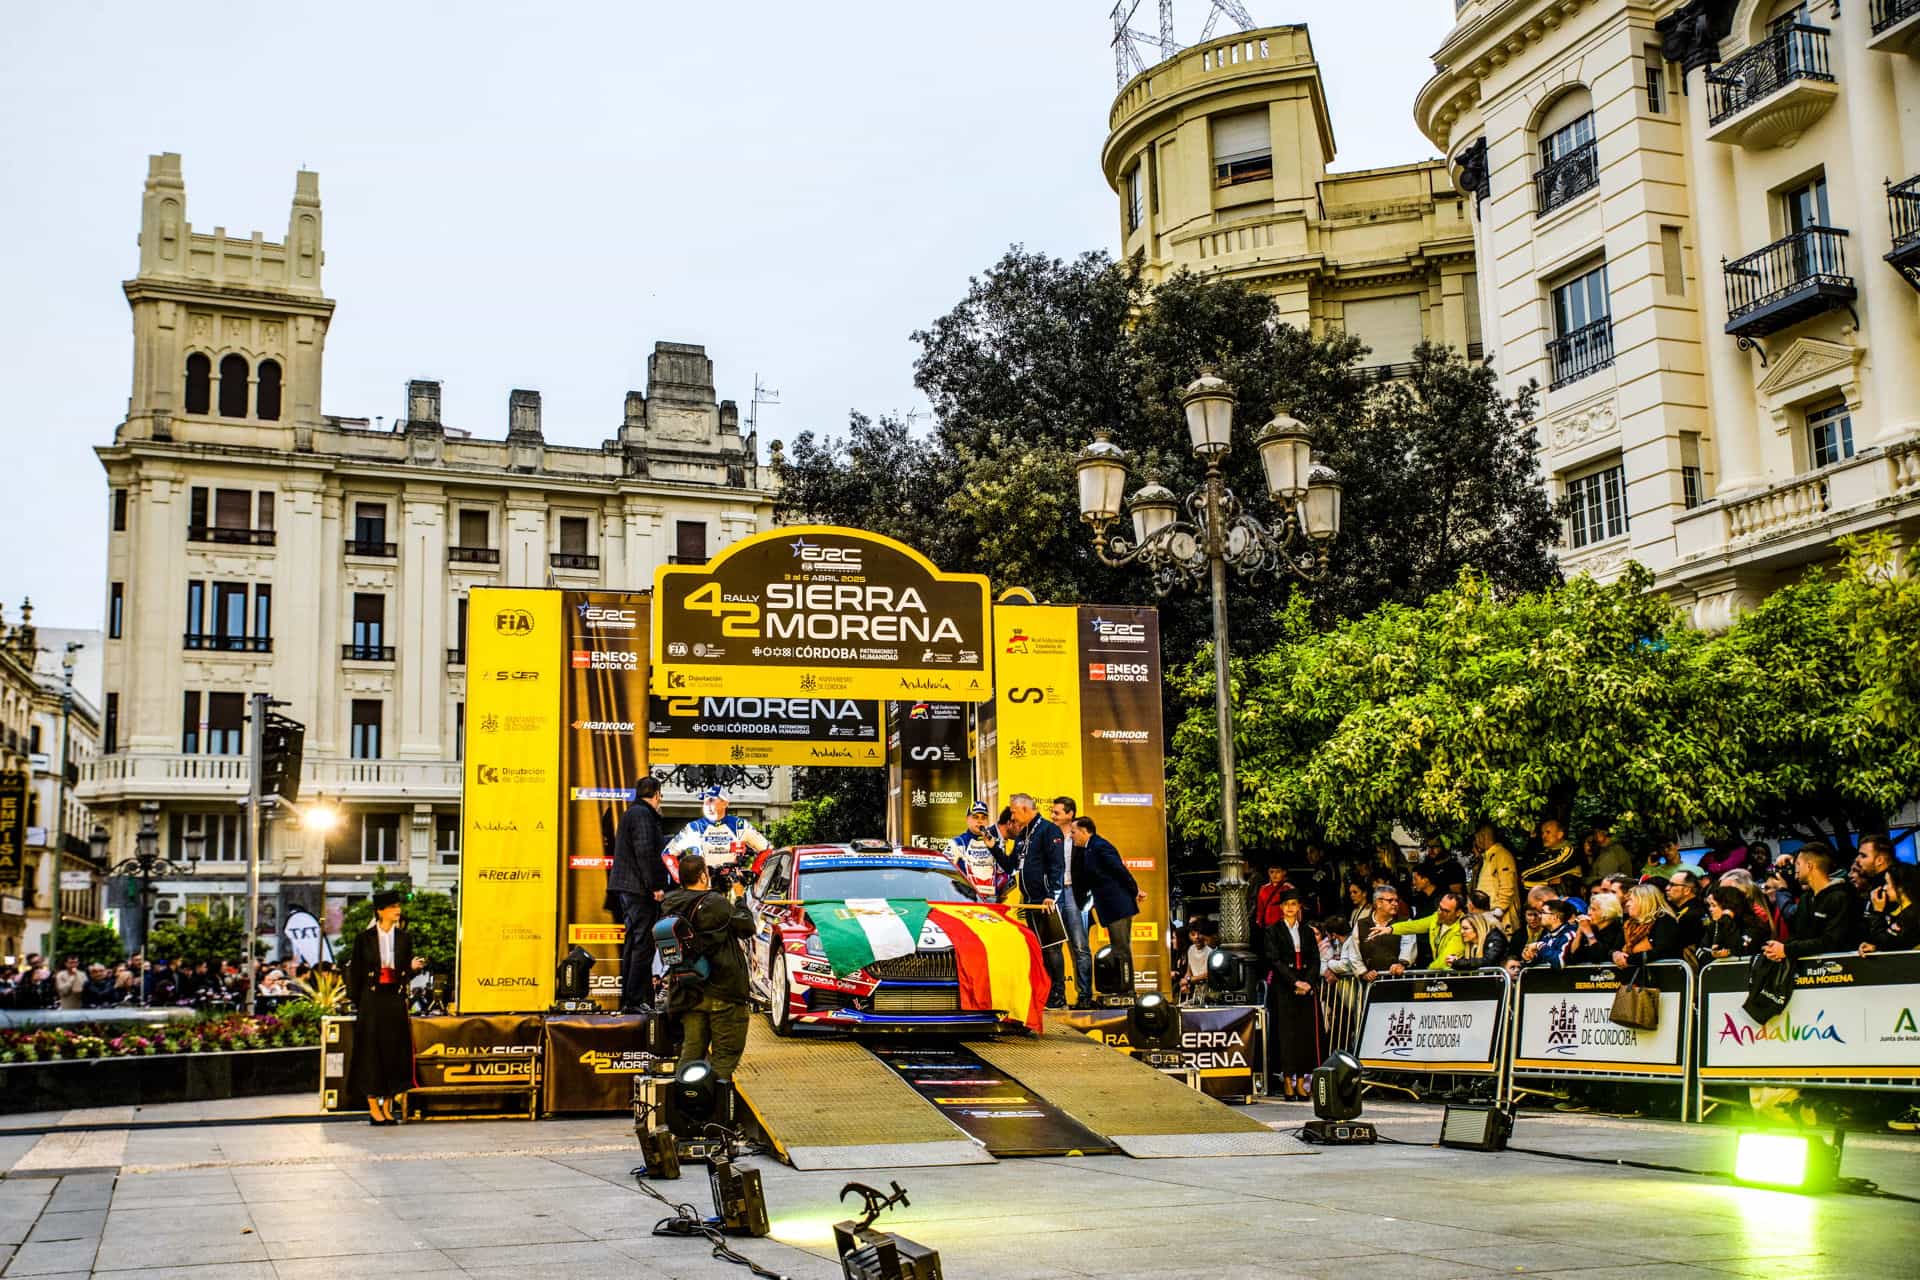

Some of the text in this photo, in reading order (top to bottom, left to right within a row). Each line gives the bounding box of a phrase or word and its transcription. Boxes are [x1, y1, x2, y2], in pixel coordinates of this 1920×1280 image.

[800, 547, 862, 562] ERC
[811, 575, 840, 583] ABRIL
[724, 594, 760, 603] RALLY
[766, 583, 928, 614] SIERRA
[586, 608, 637, 621] ERC
[766, 612, 964, 644] MORENA
[1099, 623, 1145, 636] ERC
[591, 651, 638, 663] ENEOS
[795, 645, 858, 660] CÓRDOBA
[591, 663, 623, 671] MOTOR
[1106, 664, 1148, 675] ENEOS
[1106, 674, 1149, 682] MOTOR OIL
[704, 696, 863, 720] MORENA
[727, 722, 777, 734] CÓRDOBA
[502, 767, 546, 777] Diputación
[488, 869, 532, 881] Recalvi
[1200, 882, 1217, 893] AS
[1807, 968, 1828, 978] Rally
[477, 977, 540, 987] VALRENTAL
[1816, 974, 1854, 985] MORENA
[1575, 982, 1596, 990] SIERRA
[1418, 1014, 1473, 1029] AYUNTAMIENTO
[1894, 1007, 1919, 1033] A
[1718, 1009, 1847, 1046] Andalucía
[1181, 1032, 1245, 1048] ERRA
[1416, 1033, 1426, 1047] DE
[1581, 1029, 1638, 1046] DE CORDOBA
[1183, 1052, 1248, 1068] RENA
